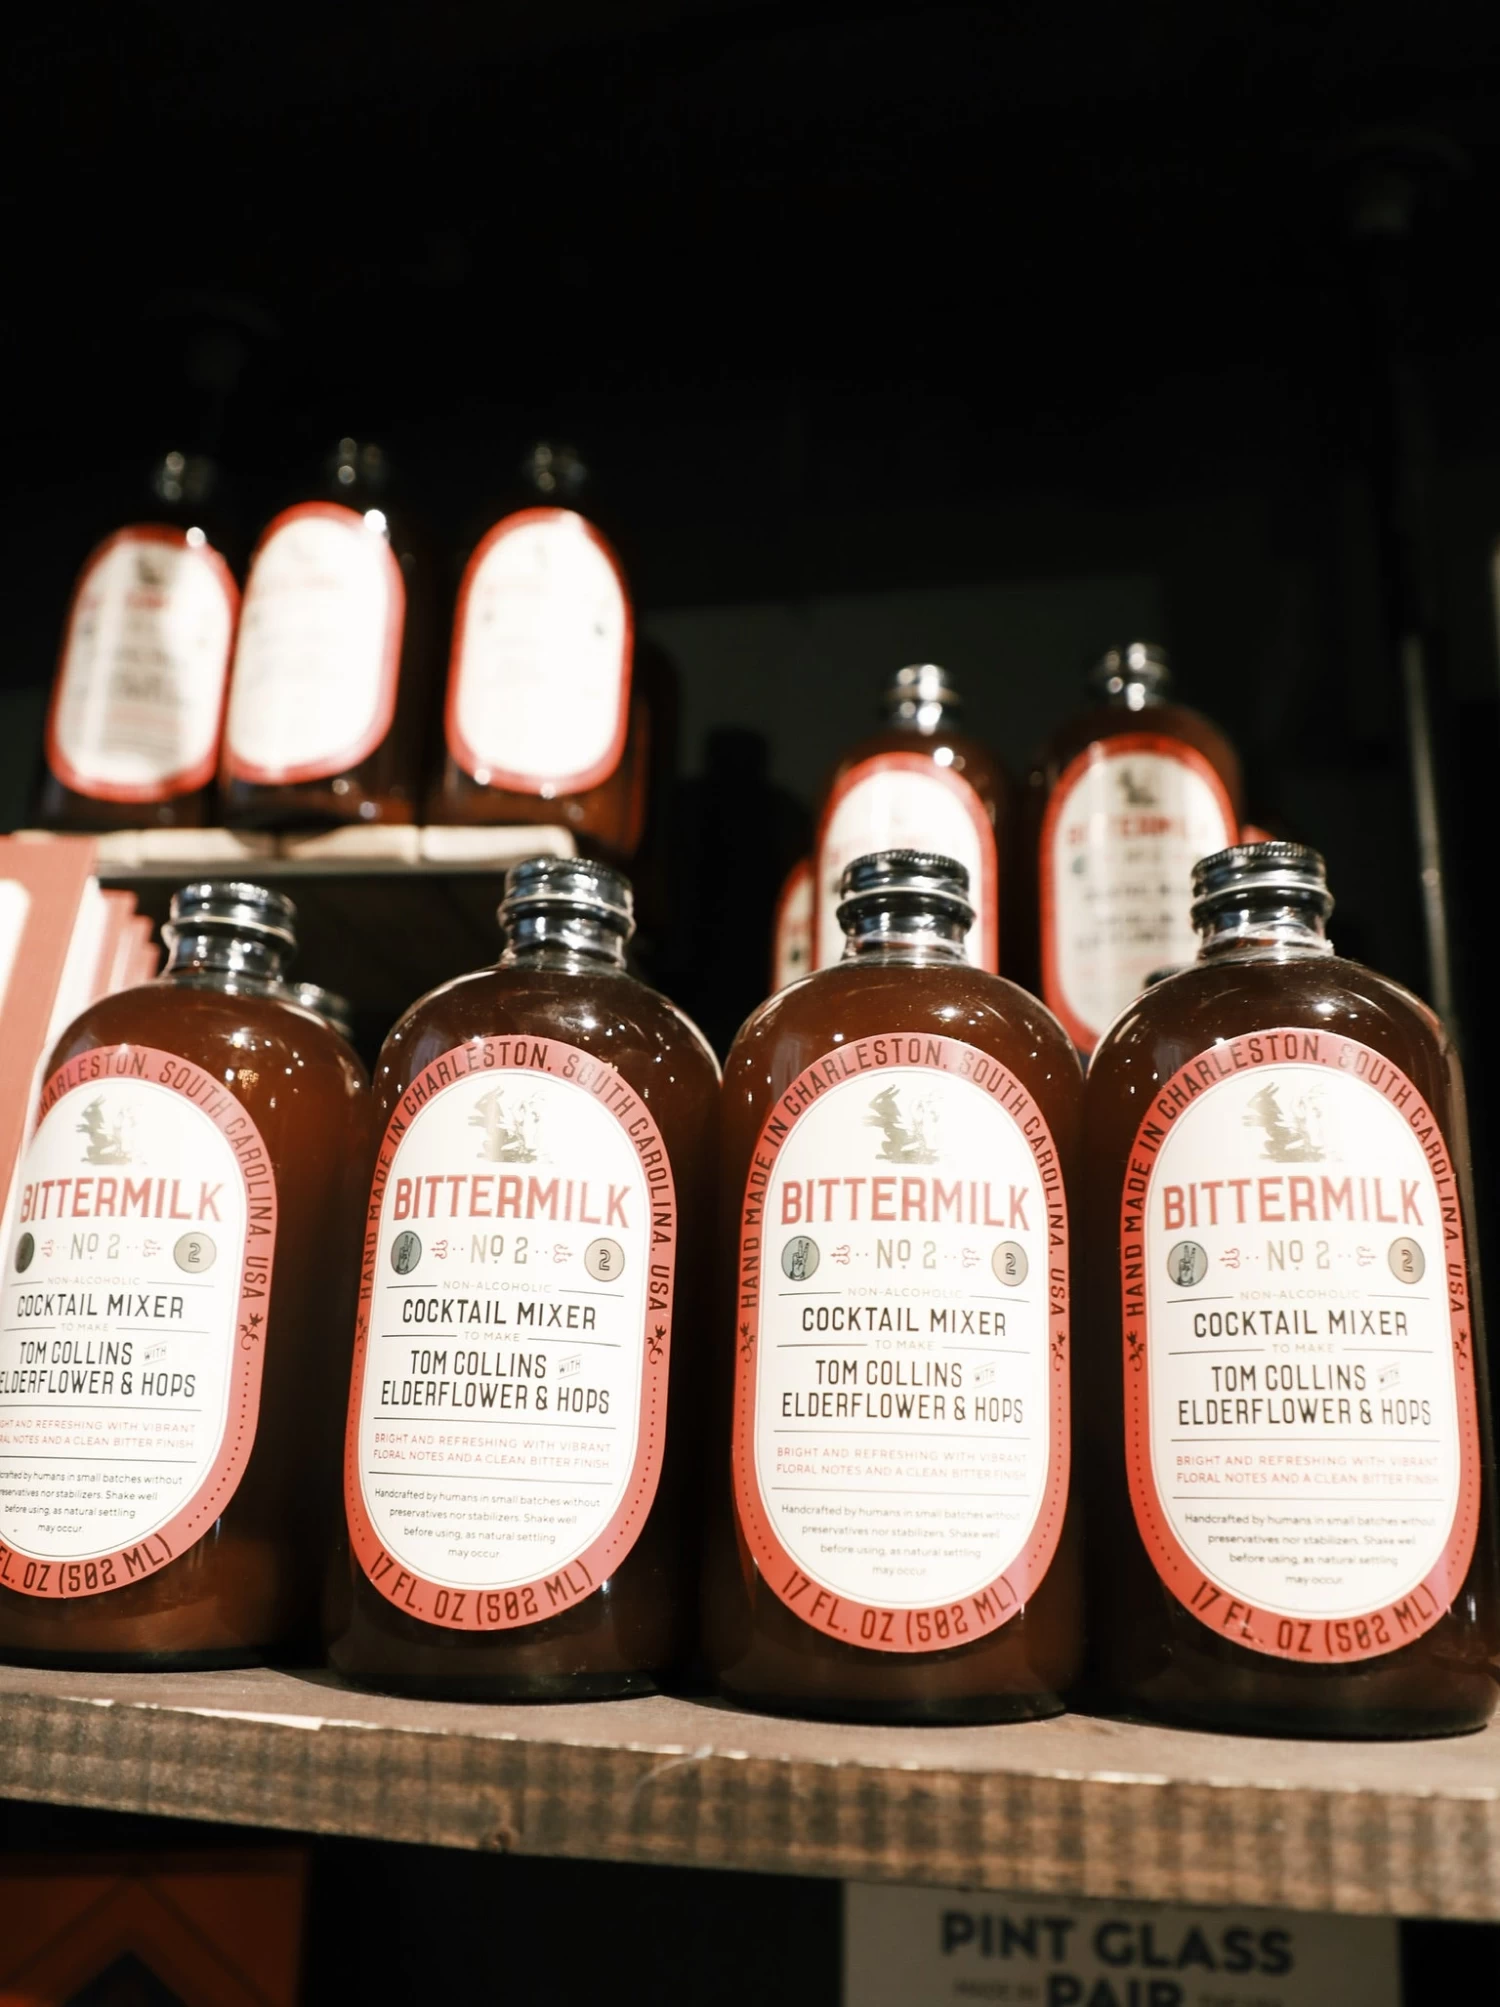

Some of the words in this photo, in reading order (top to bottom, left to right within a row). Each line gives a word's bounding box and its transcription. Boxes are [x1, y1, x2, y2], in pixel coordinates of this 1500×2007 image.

[959, 1050, 1031, 1116] SOUTH
[1338, 1043, 1413, 1108] SOUTH
[764, 1117, 789, 1148] IN
[1140, 1121, 1166, 1153] IN
[159, 1060, 232, 1116] SOUTH
[242, 1256, 268, 1300] USA
[360, 1232, 377, 1300] HAND
[369, 1153, 392, 1221] MADE
[387, 1121, 406, 1147] IN
[562, 1053, 637, 1119] SOUTH
[648, 1264, 670, 1311] USA
[744, 1152, 776, 1226] MADE
[19, 1177, 224, 1223] BITTERMILK
[393, 1174, 632, 1228] BITTERMILK
[780, 1175, 1030, 1232] BITTERMILK
[1123, 1158, 1151, 1233] MADE
[1162, 1175, 1425, 1231] BITTERMILK
[107, 1233, 120, 1259] 2
[188, 1242, 201, 1263] 2
[514, 1236, 528, 1264] 2
[599, 1249, 611, 1271] 2
[922, 1240, 936, 1269] 2
[1316, 1240, 1330, 1270] 2
[1401, 1248, 1414, 1273] 2
[741, 1237, 759, 1309] HAND
[1005, 1252, 1017, 1276] 2
[47, 1276, 140, 1286] NON-ALCOHOLIC
[443, 1280, 552, 1294] NON-ALCOHOLIC
[848, 1287, 963, 1299] NON-ALCOHOLIC
[1050, 1268, 1066, 1316] USA
[1125, 1243, 1144, 1317] HAND
[1240, 1289, 1361, 1300] NON-ALCOHOLIC
[1447, 1263, 1465, 1312] USA
[17, 1293, 98, 1317] COCKTAIL
[107, 1294, 183, 1318] MIXER
[402, 1298, 507, 1325] COCKTAIL
[516, 1301, 597, 1331] MIXER
[61, 1323, 73, 1331] TO
[77, 1323, 109, 1332] MAKE
[464, 1331, 480, 1341] TO
[483, 1331, 520, 1342] MAKE
[801, 1307, 920, 1332] COCKTAIL
[930, 1308, 1006, 1337] MIXER
[1193, 1309, 1318, 1338] COCKTAIL
[1328, 1309, 1408, 1337] MIXER
[19, 1341, 47, 1365] TOM
[51, 1341, 133, 1365] COLLINS
[875, 1339, 892, 1350] TO
[897, 1340, 936, 1351] MAKE
[1272, 1343, 1290, 1354] TO
[1294, 1343, 1334, 1354] MAKE
[410, 1349, 447, 1376] TOM
[453, 1350, 547, 1379] COLLINS
[558, 1359, 581, 1374] WITH
[815, 1359, 858, 1386] TOM
[866, 1360, 963, 1388] COLLINS
[1211, 1365, 1257, 1392] TOM
[1265, 1364, 1367, 1392] COLLINS
[120, 1371, 133, 1395] &
[141, 1372, 196, 1398] HOPS
[380, 1380, 528, 1410] ELDERFLOWER
[535, 1385, 548, 1411] &
[557, 1386, 610, 1415] HOPS
[781, 1392, 946, 1421] ELDERFLOWER
[953, 1396, 966, 1421] &
[974, 1396, 1024, 1424] HOPS
[1178, 1399, 1351, 1426] ELDERFLOWER
[1359, 1399, 1373, 1424] &
[1381, 1399, 1431, 1426] HOPS
[374, 1432, 409, 1445] BRIGHT
[410, 1435, 433, 1445] AND
[439, 1436, 518, 1449] REFRESHING
[523, 1439, 555, 1451] WITH
[560, 1441, 611, 1453] VIBRANT
[777, 1447, 818, 1458] BRIGHT
[822, 1448, 849, 1458] AND
[854, 1449, 938, 1461] REFRESHING
[943, 1451, 975, 1462] WITH
[979, 1452, 1027, 1463] VIBRANT
[373, 1449, 406, 1460] FLORAL
[408, 1451, 445, 1461] NOTES
[447, 1452, 473, 1463] AND
[474, 1454, 482, 1463] A
[485, 1454, 526, 1465] CLEAN
[530, 1456, 571, 1467] BITTER
[573, 1458, 610, 1468] FINISH
[1176, 1455, 1220, 1466] BRIGHT
[1225, 1456, 1252, 1466] AND
[1259, 1456, 1347, 1467] REFRESHING
[1352, 1456, 1385, 1467] WITH
[1390, 1456, 1438, 1467] VIBRANT
[4, 1504, 27, 1514] before
[64, 1507, 96, 1516] natural
[98, 1508, 136, 1519] settling
[374, 1488, 425, 1501] Handcrafted
[426, 1490, 438, 1502] by
[439, 1491, 478, 1502] humans
[480, 1493, 489, 1502] in
[491, 1494, 518, 1504] small
[520, 1495, 561, 1506] batches
[561, 1497, 600, 1508] without
[389, 1507, 448, 1521] preservatives
[450, 1511, 466, 1520] nor
[523, 1513, 555, 1524] Shake
[557, 1514, 577, 1524] well
[403, 1527, 433, 1537] before
[465, 1530, 476, 1540] as
[478, 1530, 515, 1542] natural
[517, 1532, 556, 1545] settling
[23, 1562, 51, 1591] OZ
[59, 1558, 116, 1594] (502
[122, 1533, 173, 1578] ML)
[447, 1548, 469, 1559] may
[370, 1551, 394, 1581] 17
[391, 1571, 423, 1612] FL.
[434, 1592, 468, 1622] OZ
[476, 1587, 539, 1625] (502
[544, 1559, 594, 1606] ML)
[781, 1571, 811, 1600] 17
[809, 1590, 848, 1633] FL.
[860, 1609, 894, 1642] OZ
[906, 1606, 968, 1645] (502
[977, 1574, 1018, 1625] ML)
[1188, 1581, 1222, 1612] 17
[1222, 1606, 1264, 1645] FL.
[1277, 1618, 1312, 1653] OZ
[1324, 1613, 1391, 1656] (502
[1398, 1582, 1440, 1634] ML)
[939, 1908, 1077, 1964] PINT
[1091, 1918, 1296, 1976] GLASS
[1045, 1970, 1185, 2007] PAIR
